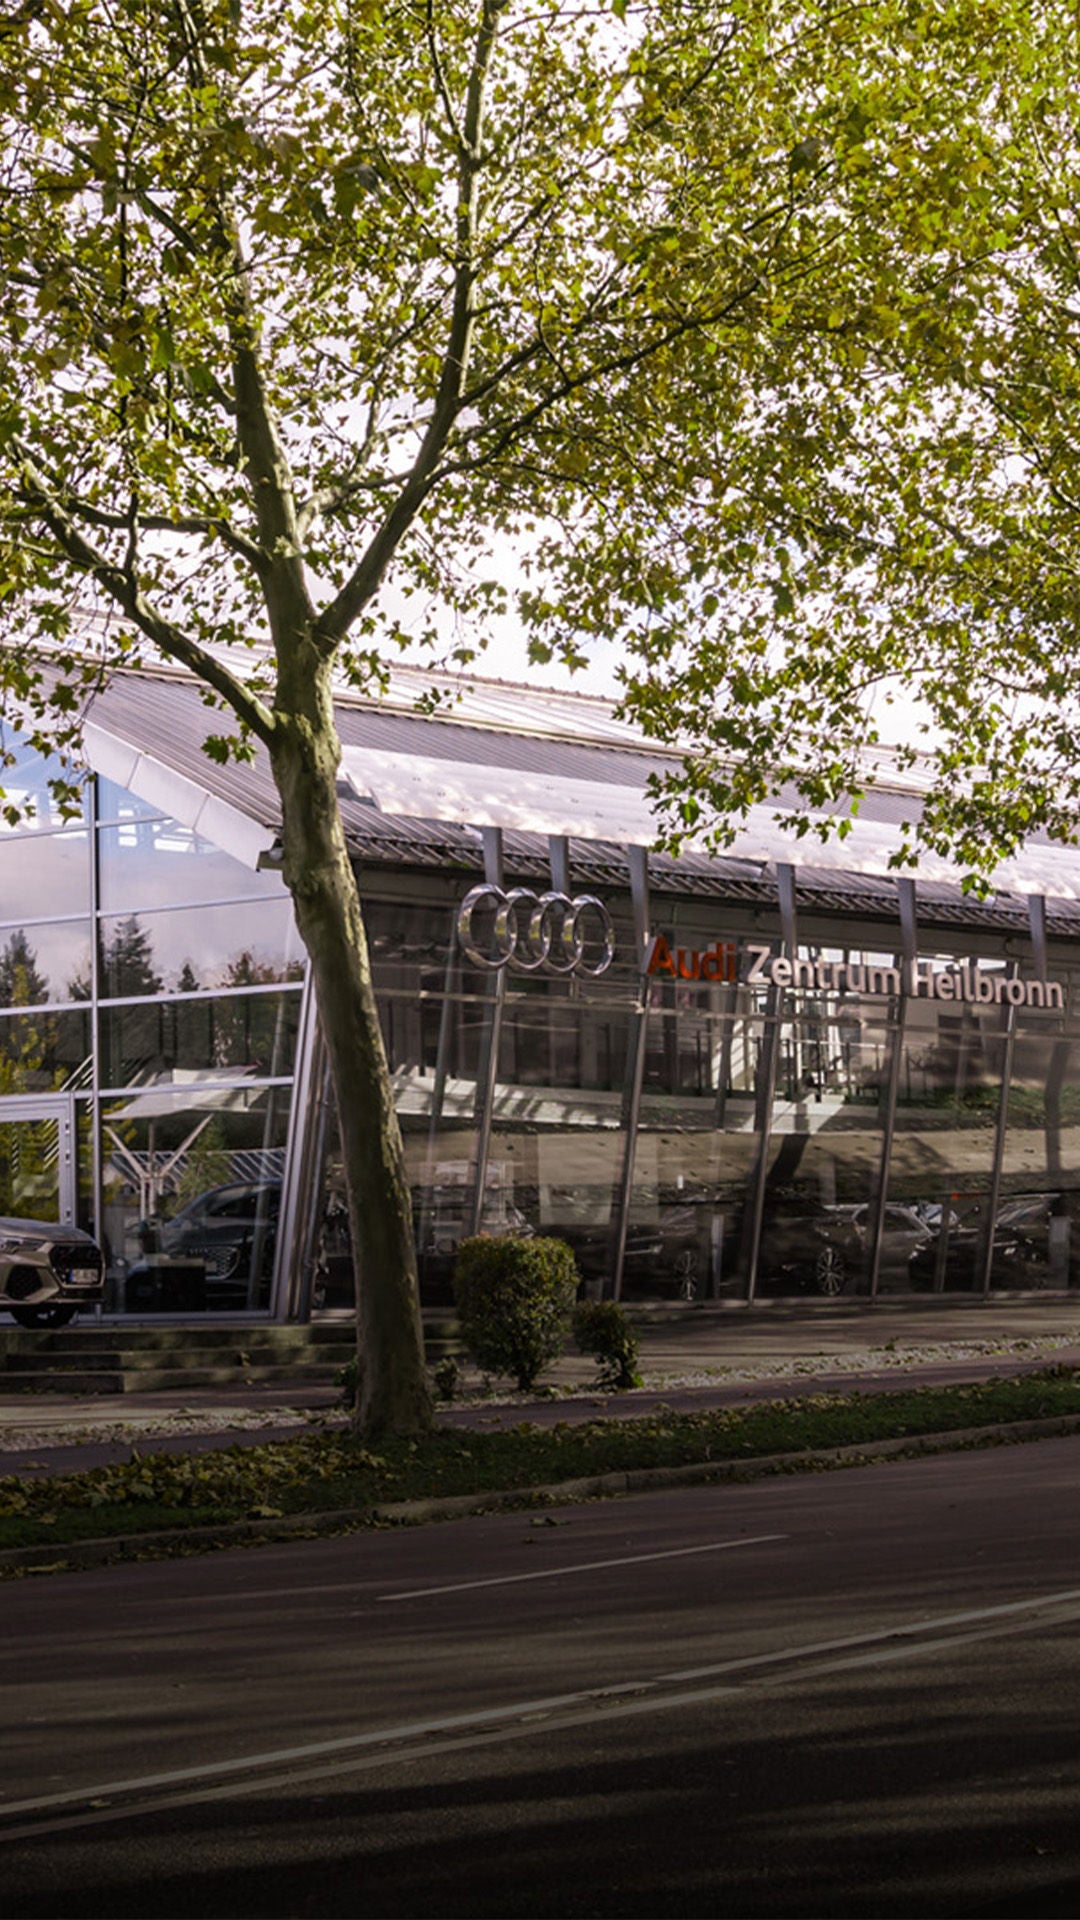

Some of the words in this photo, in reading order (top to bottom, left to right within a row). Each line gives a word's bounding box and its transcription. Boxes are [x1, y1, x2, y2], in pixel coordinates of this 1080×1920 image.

[646, 935, 736, 982] Audi
[746, 945, 900, 994] Zentrum
[910, 960, 1064, 1008] Heilbronn
